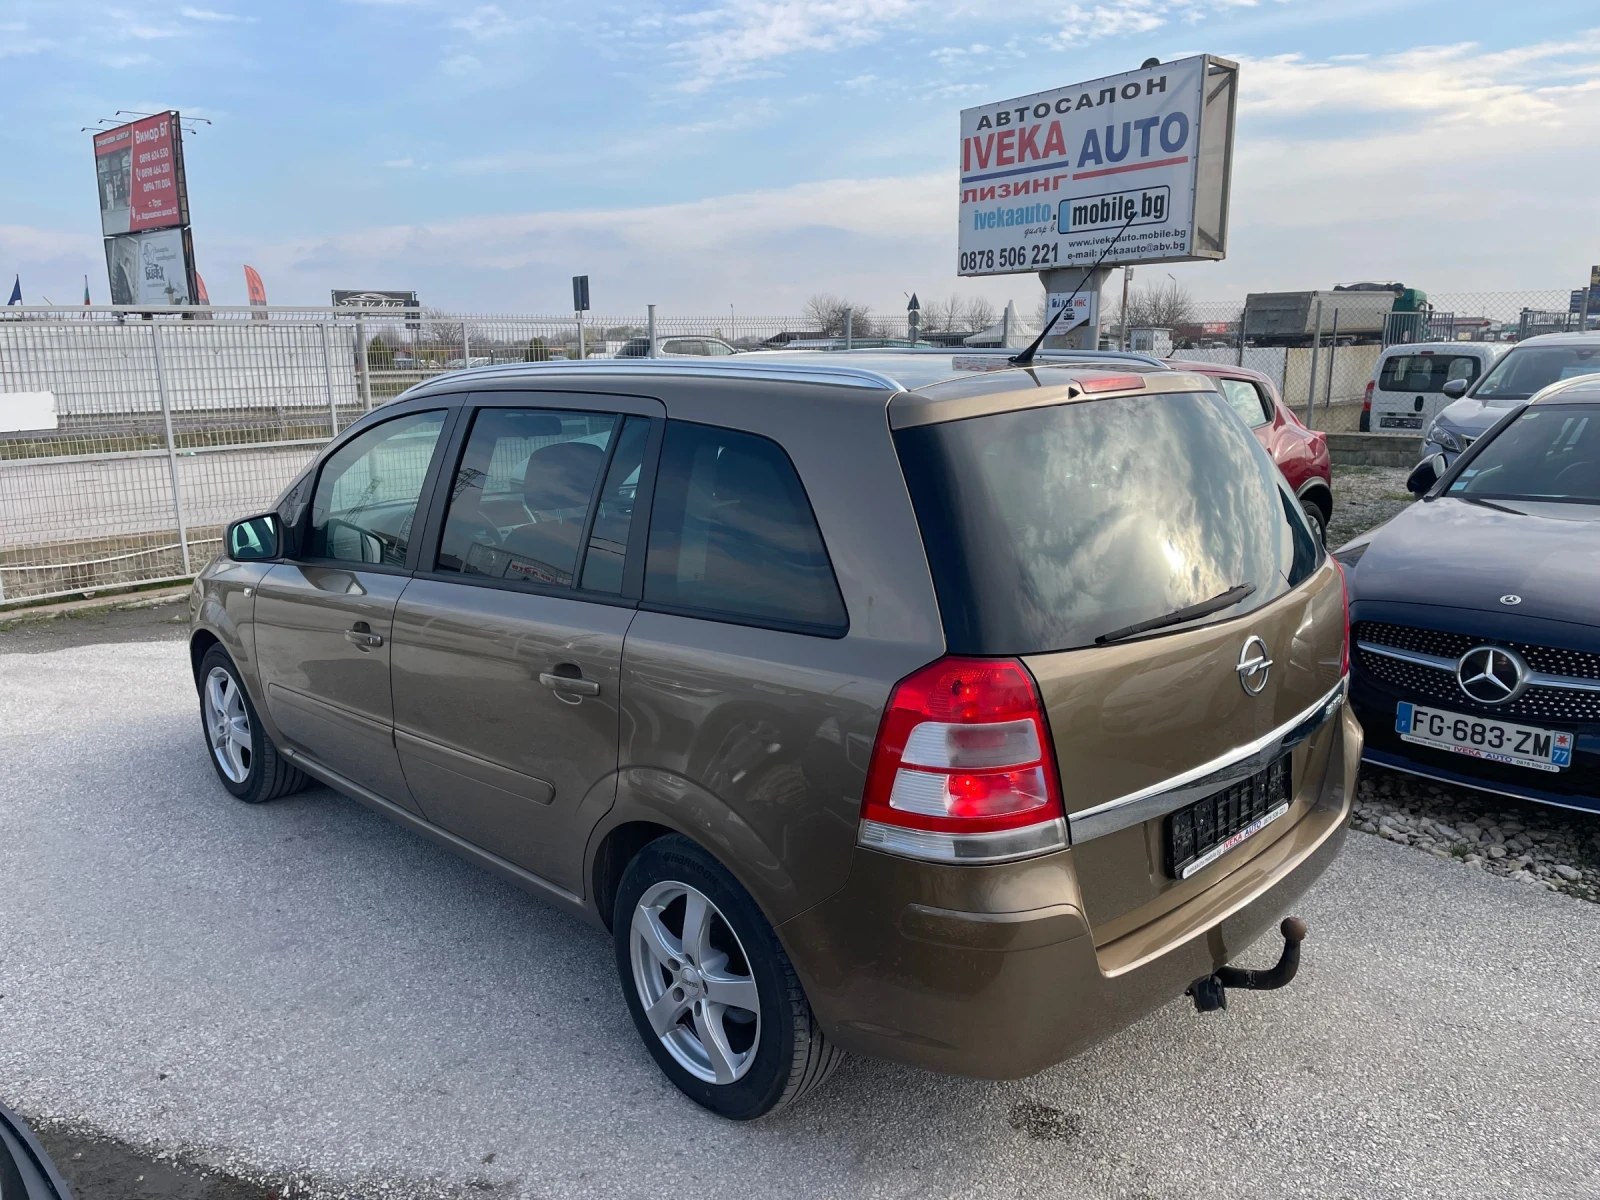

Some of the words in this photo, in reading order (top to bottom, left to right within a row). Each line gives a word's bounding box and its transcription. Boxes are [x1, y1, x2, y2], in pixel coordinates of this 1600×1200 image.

[976, 75, 1167, 131] АВТОСАЛОН
[160, 122, 168, 137] БГ
[963, 120, 1067, 172] IVEKA
[1076, 111, 1189, 168] AUTO
[961, 174, 1068, 204] ЛИЗИНГ
[1072, 192, 1165, 226] mobile.bg
[960, 248, 994, 271] 0878
[999, 246, 1027, 267] 506
[1031, 242, 1059, 265] 221
[1067, 249, 1097, 260] e-mail:
[1401, 720, 1406, 728] F
[1412, 710, 1552, 758] FG-683-ZM
[1454, 746, 1481, 757] IVEKA
[1486, 753, 1512, 763] AUTO
[1554, 750, 1568, 762] 77
[1223, 833, 1243, 850] IVEKA
[1245, 820, 1262, 836] AUTO
